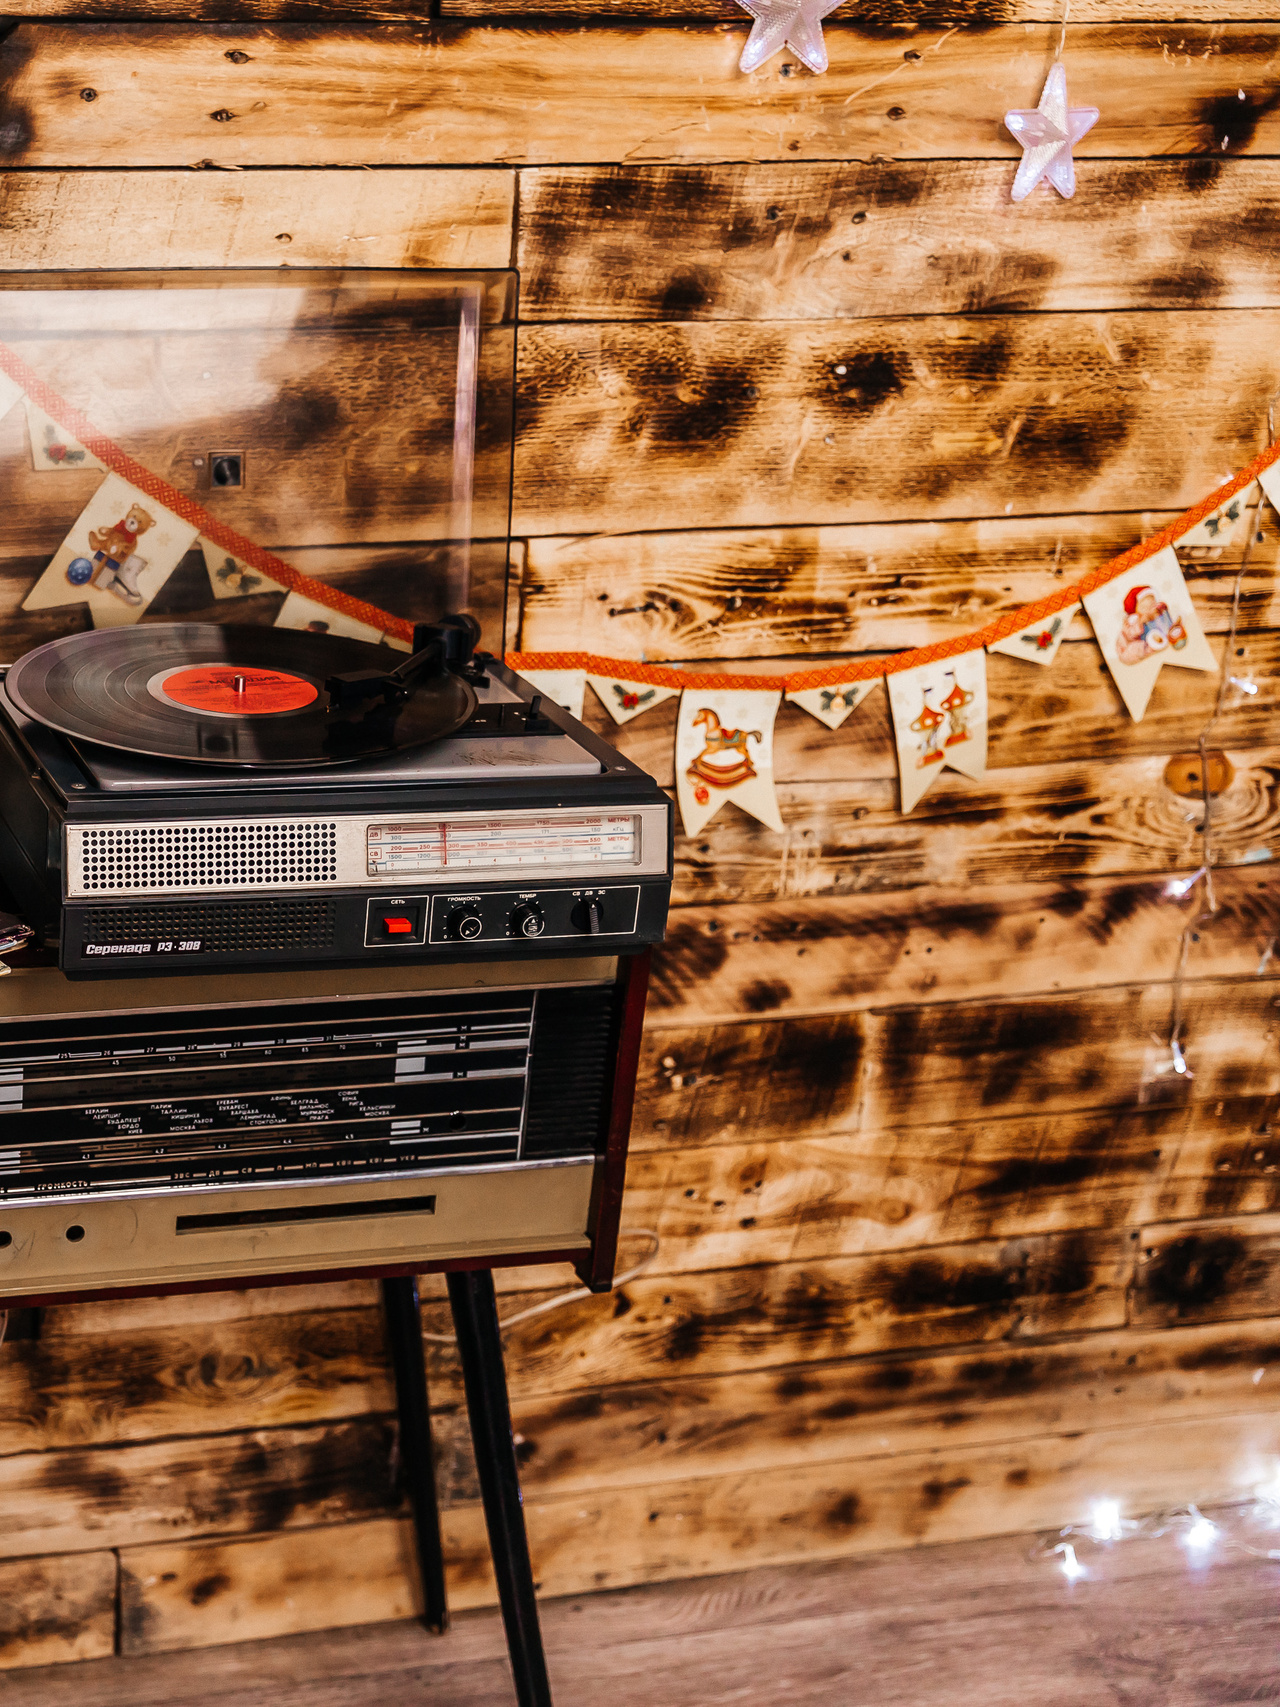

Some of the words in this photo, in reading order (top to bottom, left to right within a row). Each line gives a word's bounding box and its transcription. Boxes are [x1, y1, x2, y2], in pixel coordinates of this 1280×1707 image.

[86, 944, 151, 955] Серенада
[219, 1103, 249, 1111] БУХАРЕСТ
[107, 1117, 141, 1125] БУДАПЕШТ
[37, 1180, 88, 1191] ГРОМКОСТЬ
